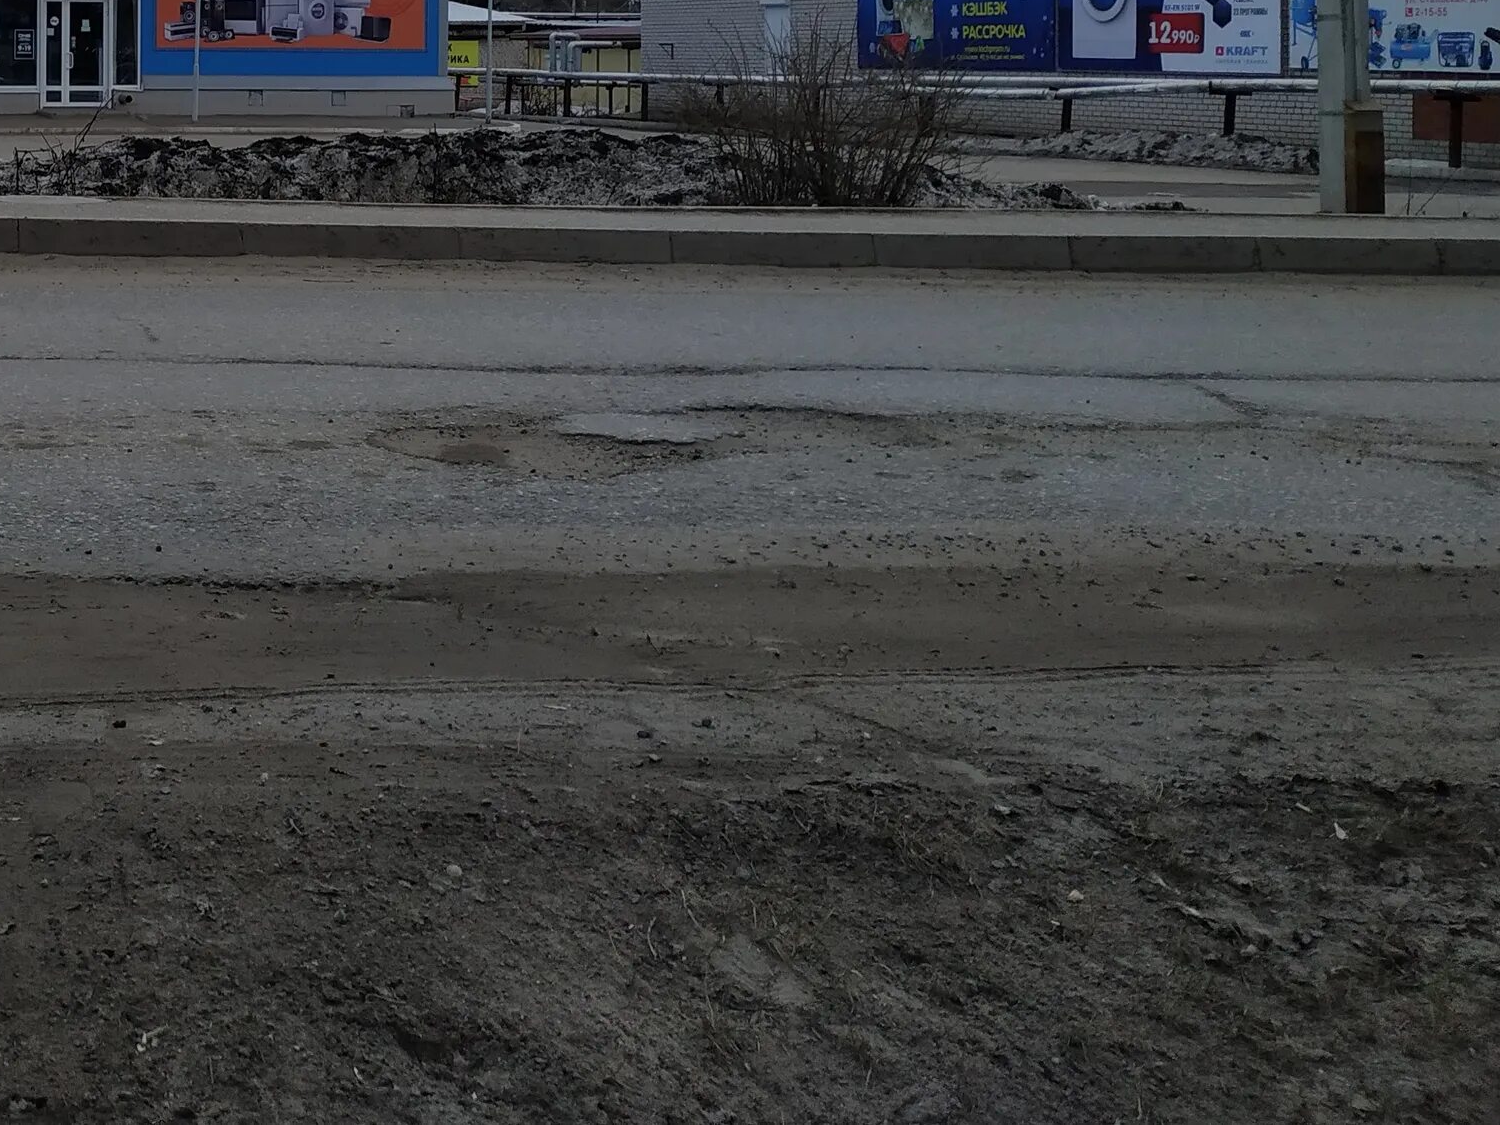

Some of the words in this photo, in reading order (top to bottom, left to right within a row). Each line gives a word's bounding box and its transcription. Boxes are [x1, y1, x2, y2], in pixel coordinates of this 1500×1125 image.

[962, 1, 1008, 16] КЭШБЭК
[1415, 7, 1448, 17] 2-15-55
[962, 24, 1026, 39] РАССРОЧКА
[1226, 46, 1268, 56] KRAFT
[447, 54, 470, 64] ИКА
